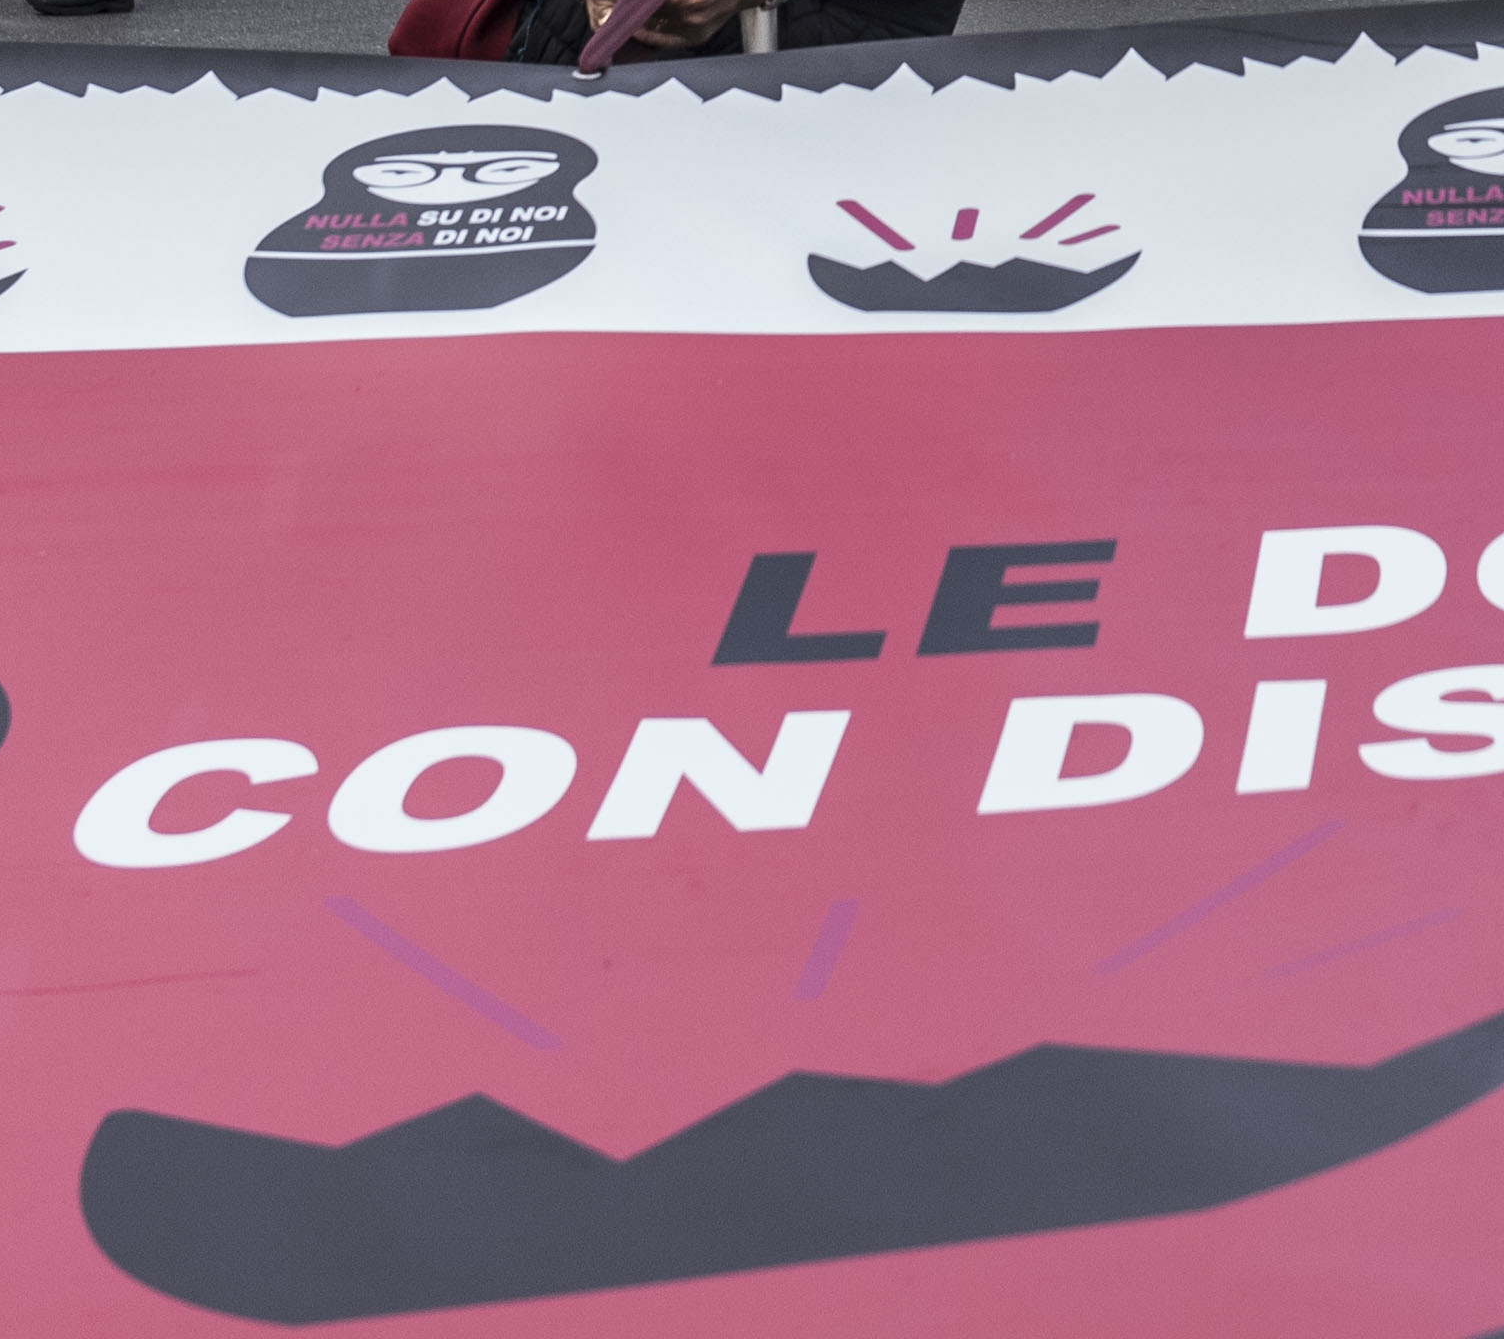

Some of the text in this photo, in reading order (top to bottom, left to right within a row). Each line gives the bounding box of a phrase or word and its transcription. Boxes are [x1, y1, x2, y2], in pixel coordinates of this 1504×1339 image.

[1401, 186, 1504, 206] NULLA
[305, 205, 569, 230] NULLA SU DI NOI
[320, 225, 534, 250] SENZA DI NOI
[711, 539, 1118, 666] LE
[72, 709, 852, 869] CON
